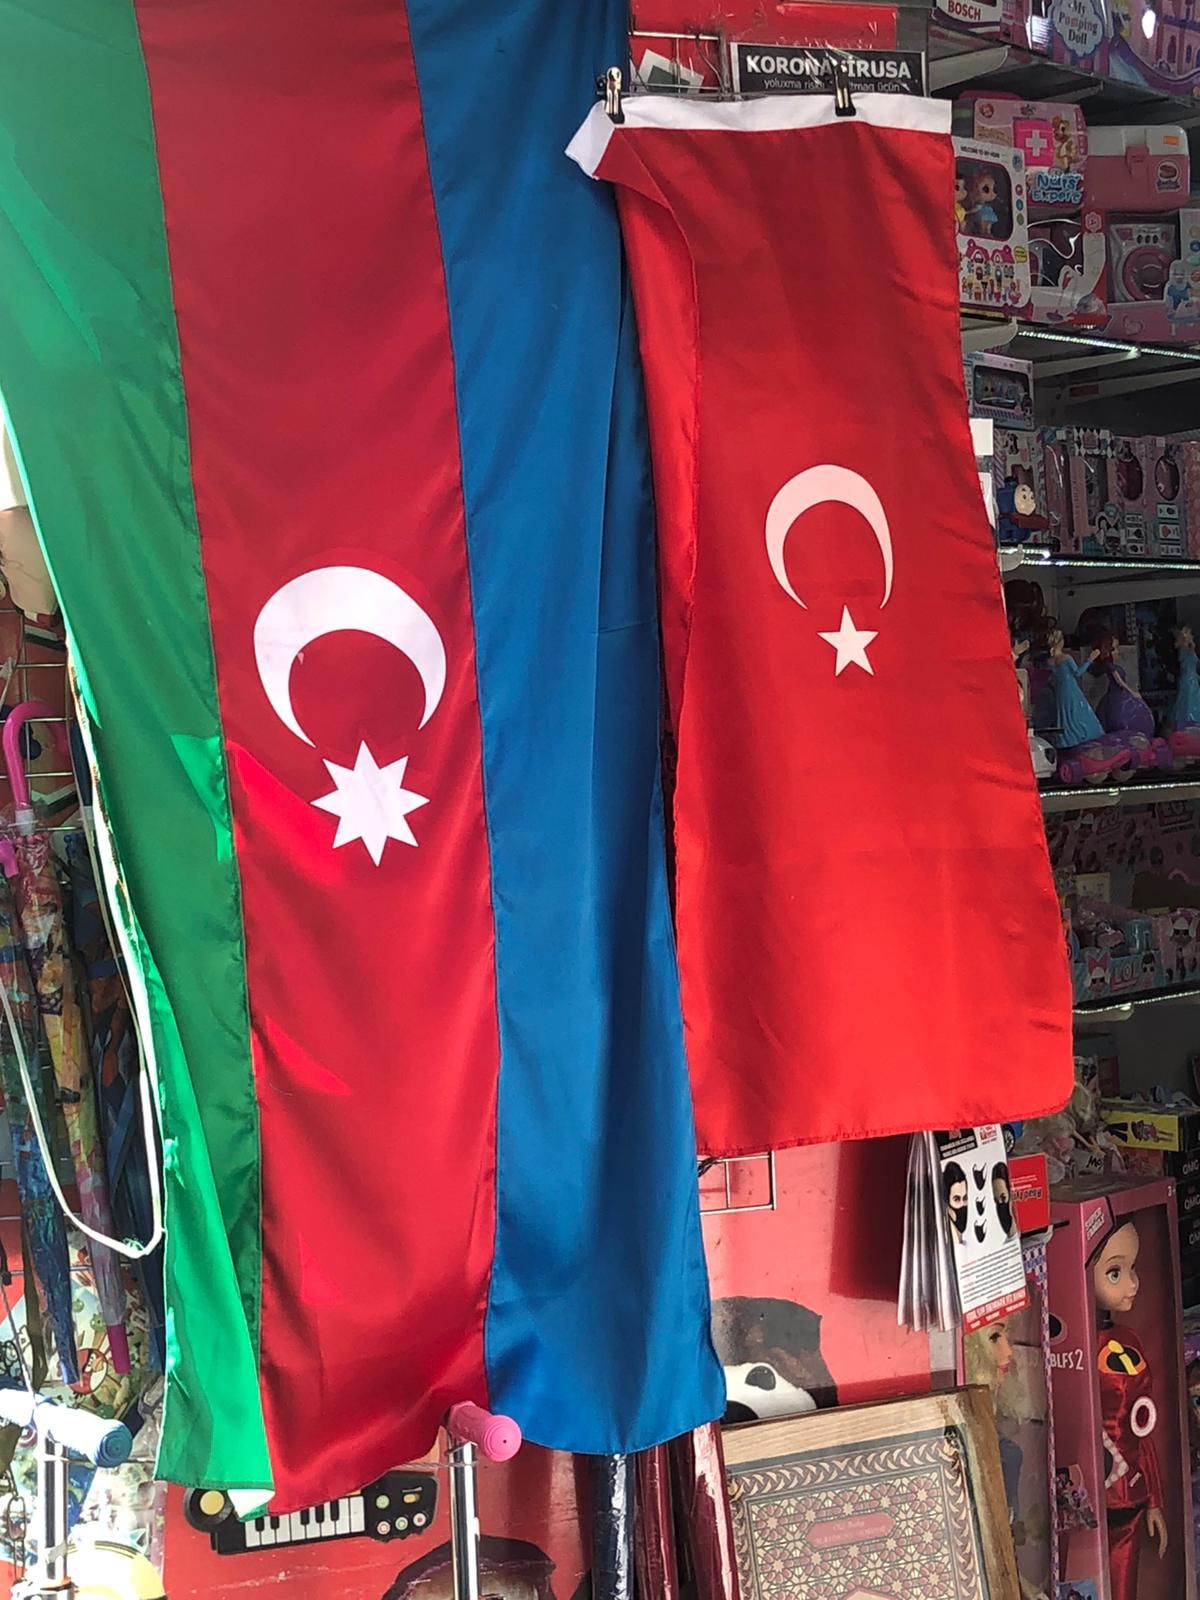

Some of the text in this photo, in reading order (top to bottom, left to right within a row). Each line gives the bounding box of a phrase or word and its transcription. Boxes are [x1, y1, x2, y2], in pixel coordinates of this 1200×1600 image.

[948, 0, 981, 20] BOSCH
[1068, 29, 1087, 45] Doll
[746, 55, 911, 79] KORONAİRUSA
[1074, 1348, 1084, 1370] 2
